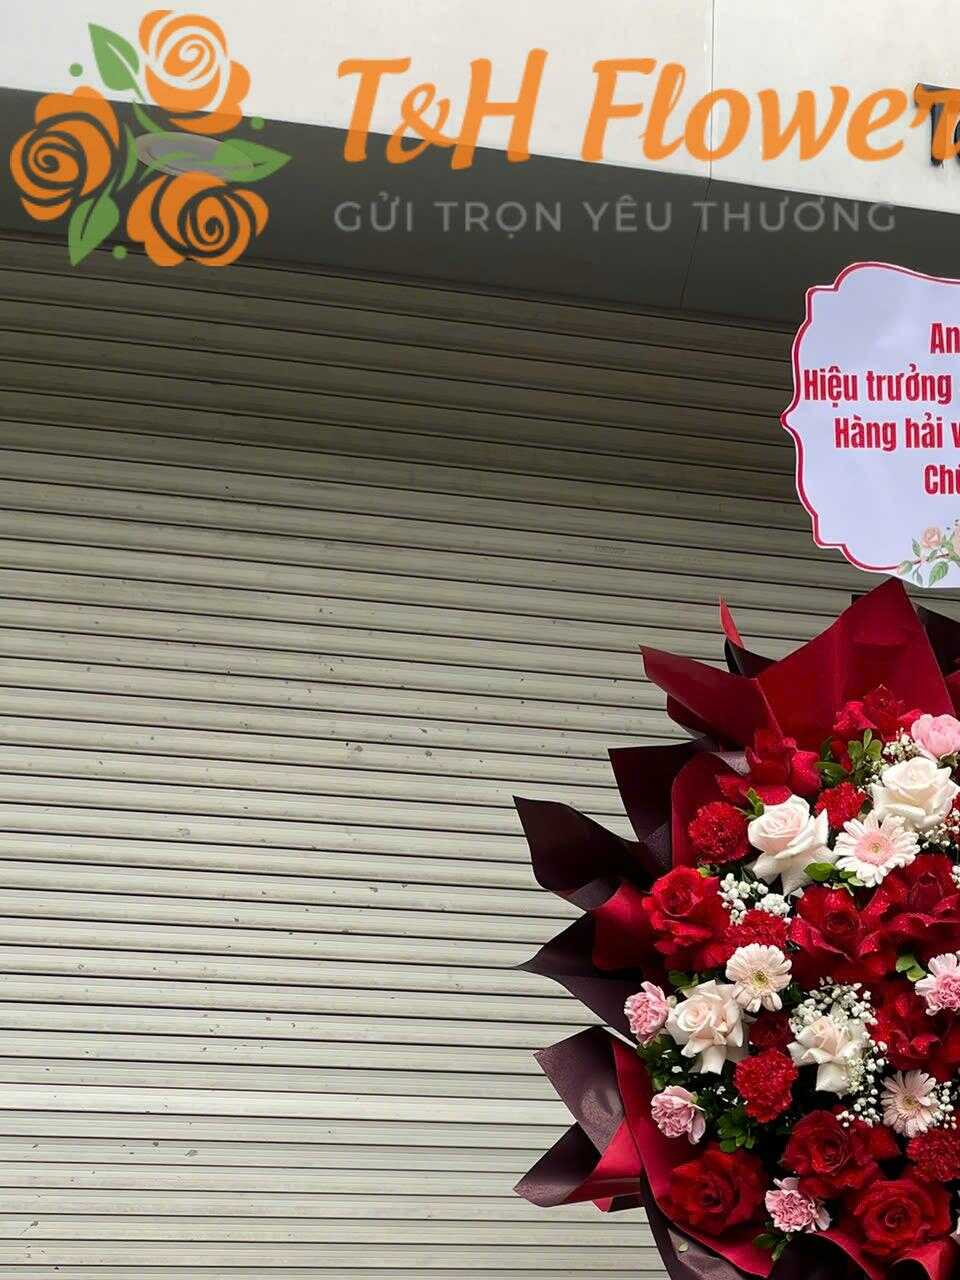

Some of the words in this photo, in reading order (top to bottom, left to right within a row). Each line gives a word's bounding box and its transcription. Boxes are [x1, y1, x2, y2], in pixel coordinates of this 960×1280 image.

[803, 365, 858, 408] Hiệu
[866, 363, 952, 405] trưởng
[835, 414, 897, 451] Hàng
[905, 412, 943, 448] hải
